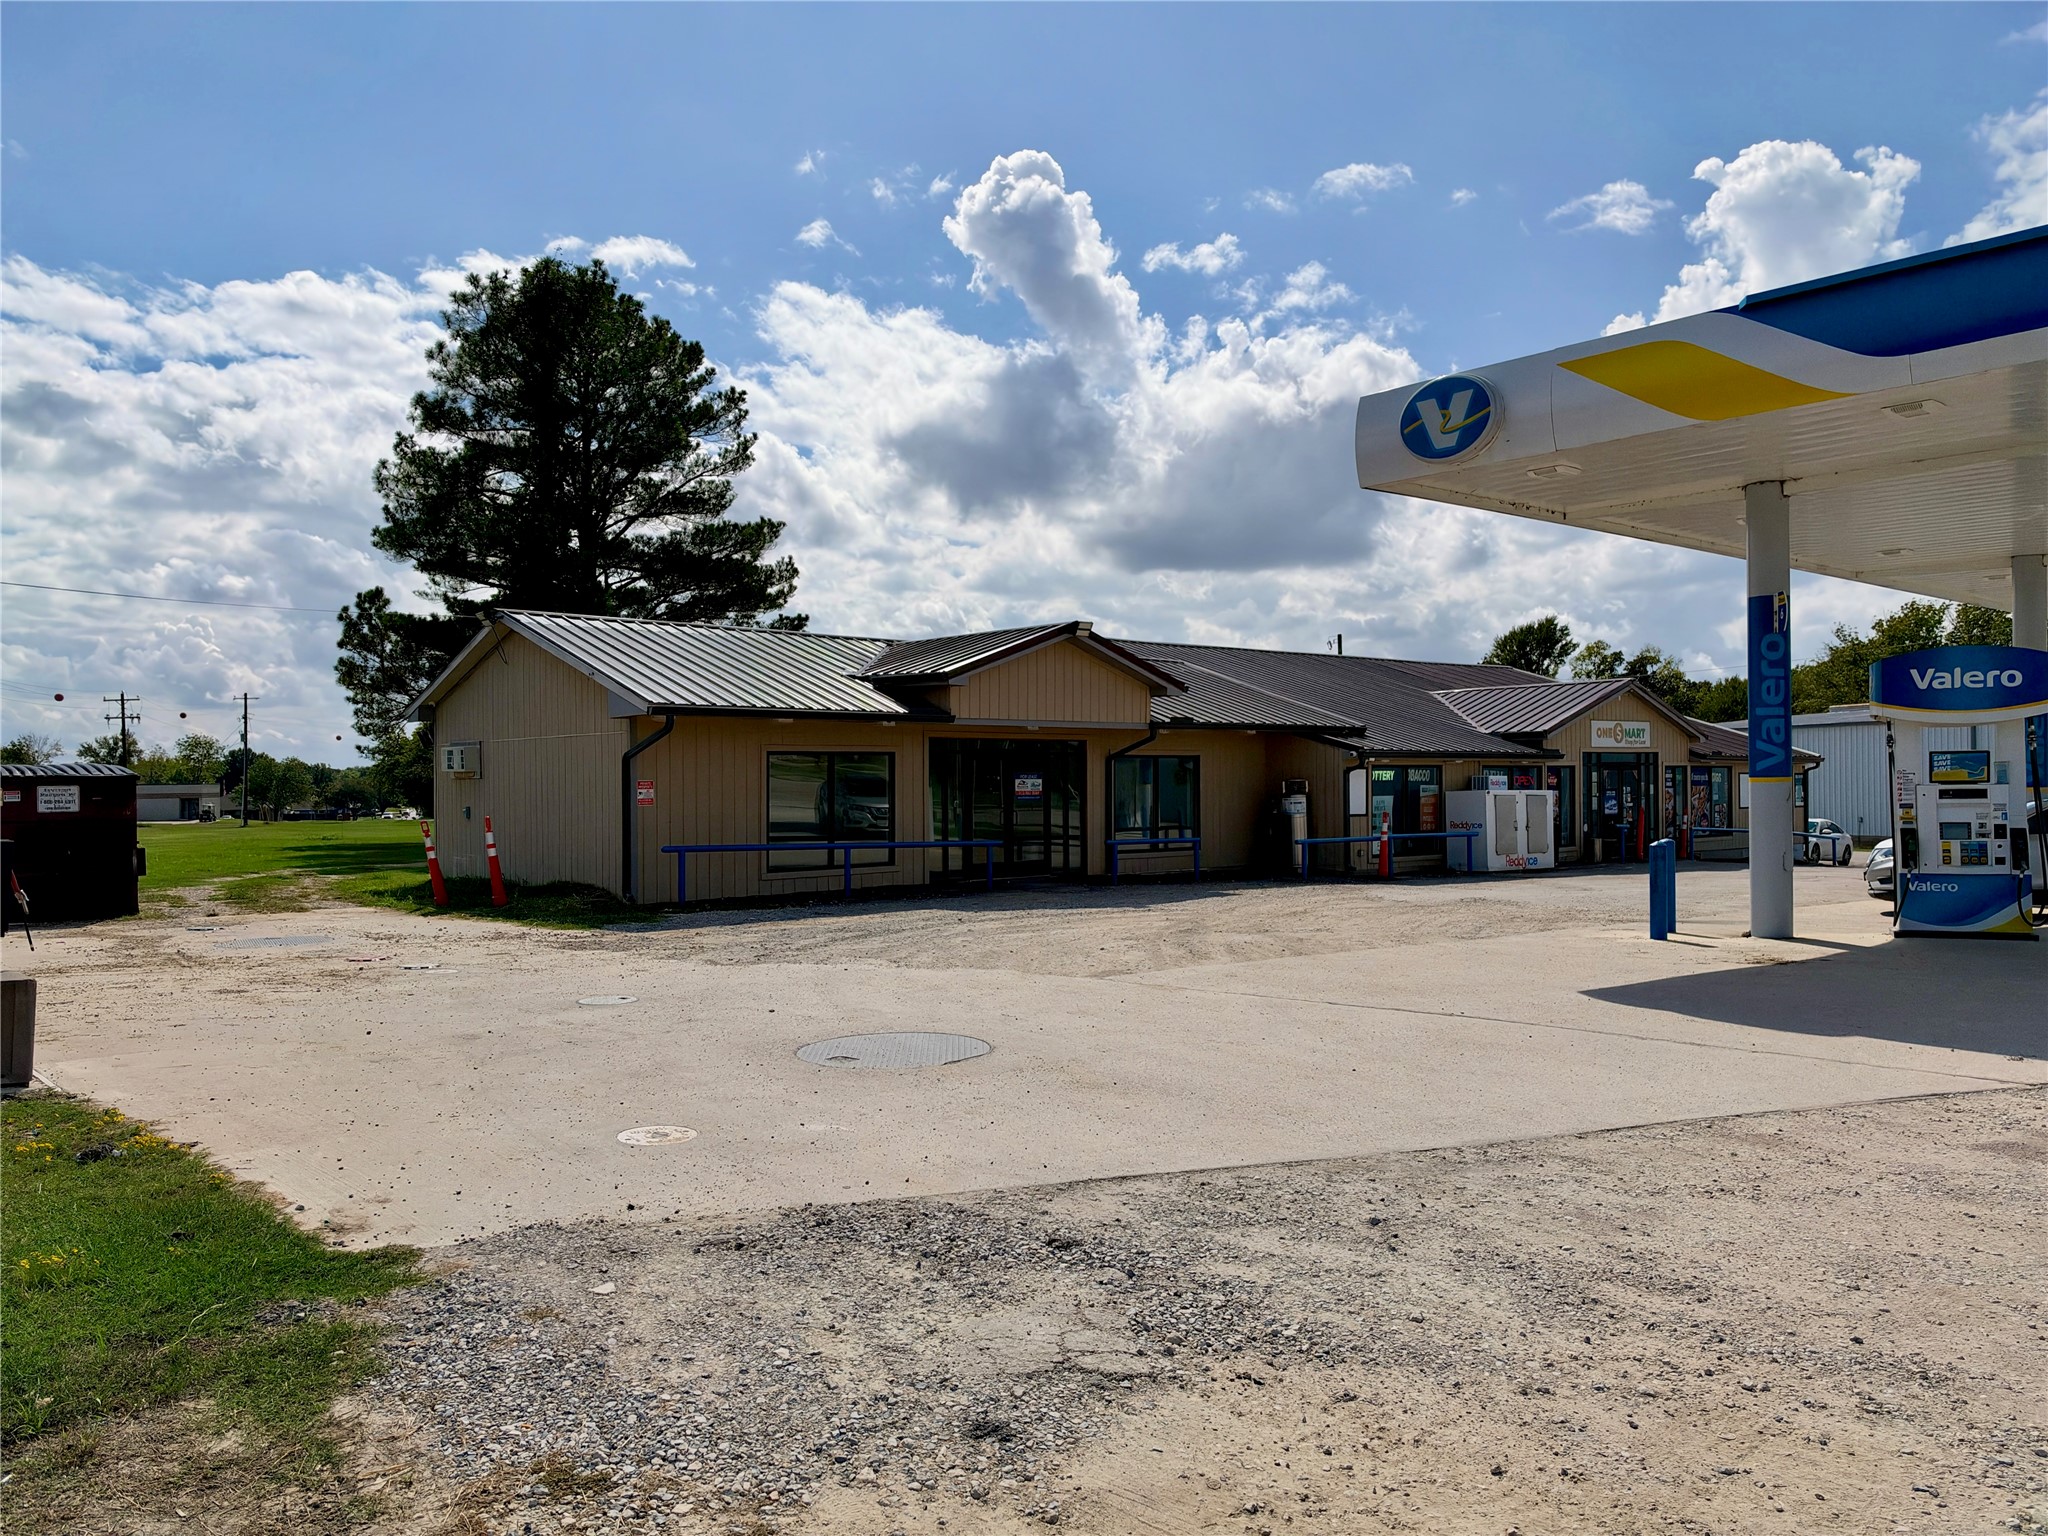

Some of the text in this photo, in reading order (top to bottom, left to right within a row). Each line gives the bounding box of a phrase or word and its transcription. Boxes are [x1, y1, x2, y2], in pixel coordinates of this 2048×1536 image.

[1909, 667, 2023, 690] Valero
[1756, 633, 1785, 772] Valero
[1513, 775, 1535, 785] OPEN
[1909, 881, 1958, 892] Valero
